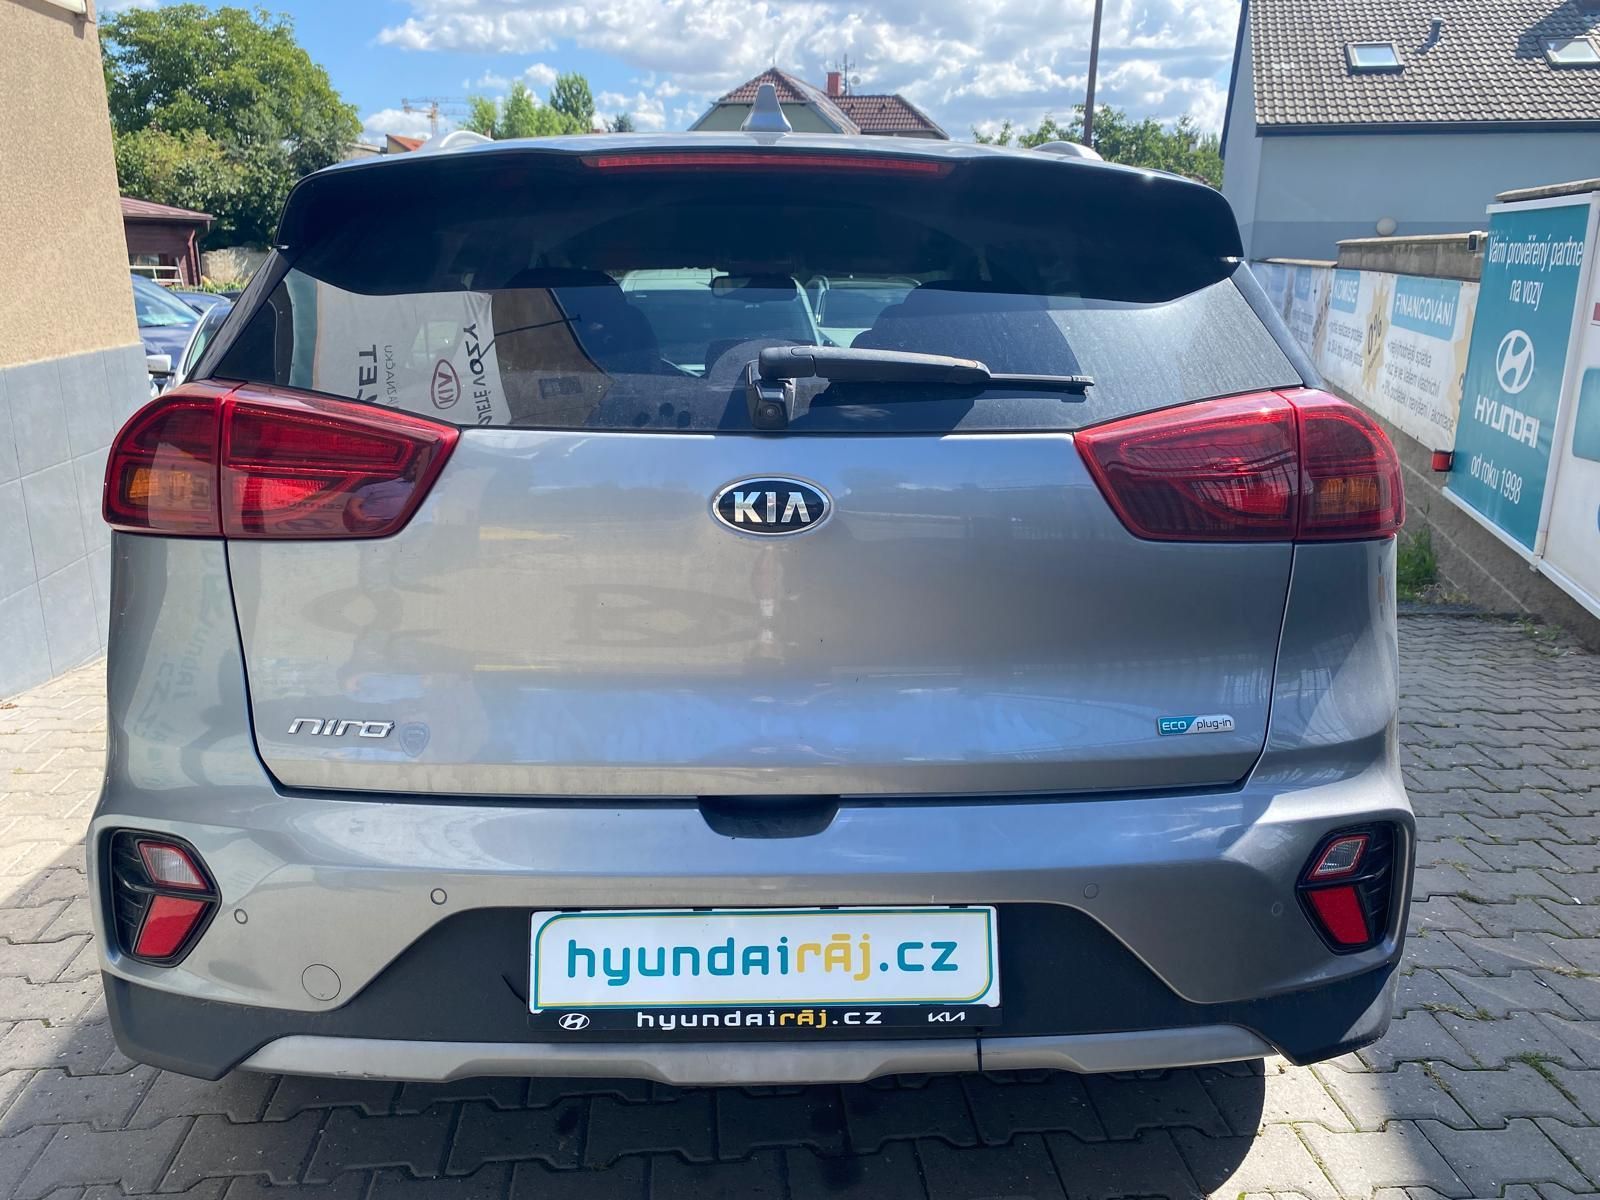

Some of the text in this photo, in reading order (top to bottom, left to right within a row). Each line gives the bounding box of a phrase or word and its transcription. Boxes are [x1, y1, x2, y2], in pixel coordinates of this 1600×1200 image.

[1488, 233, 1584, 272] Vámi prověřený partne
[1395, 293, 1456, 327] FINANCOVÁNÍ
[1509, 279, 1544, 311] na vozy
[1474, 394, 1540, 449] HYUNDAI
[1470, 453, 1523, 505] od roku 1998
[733, 491, 811, 523] KIA
[1162, 718, 1232, 731] ECO plug-in
